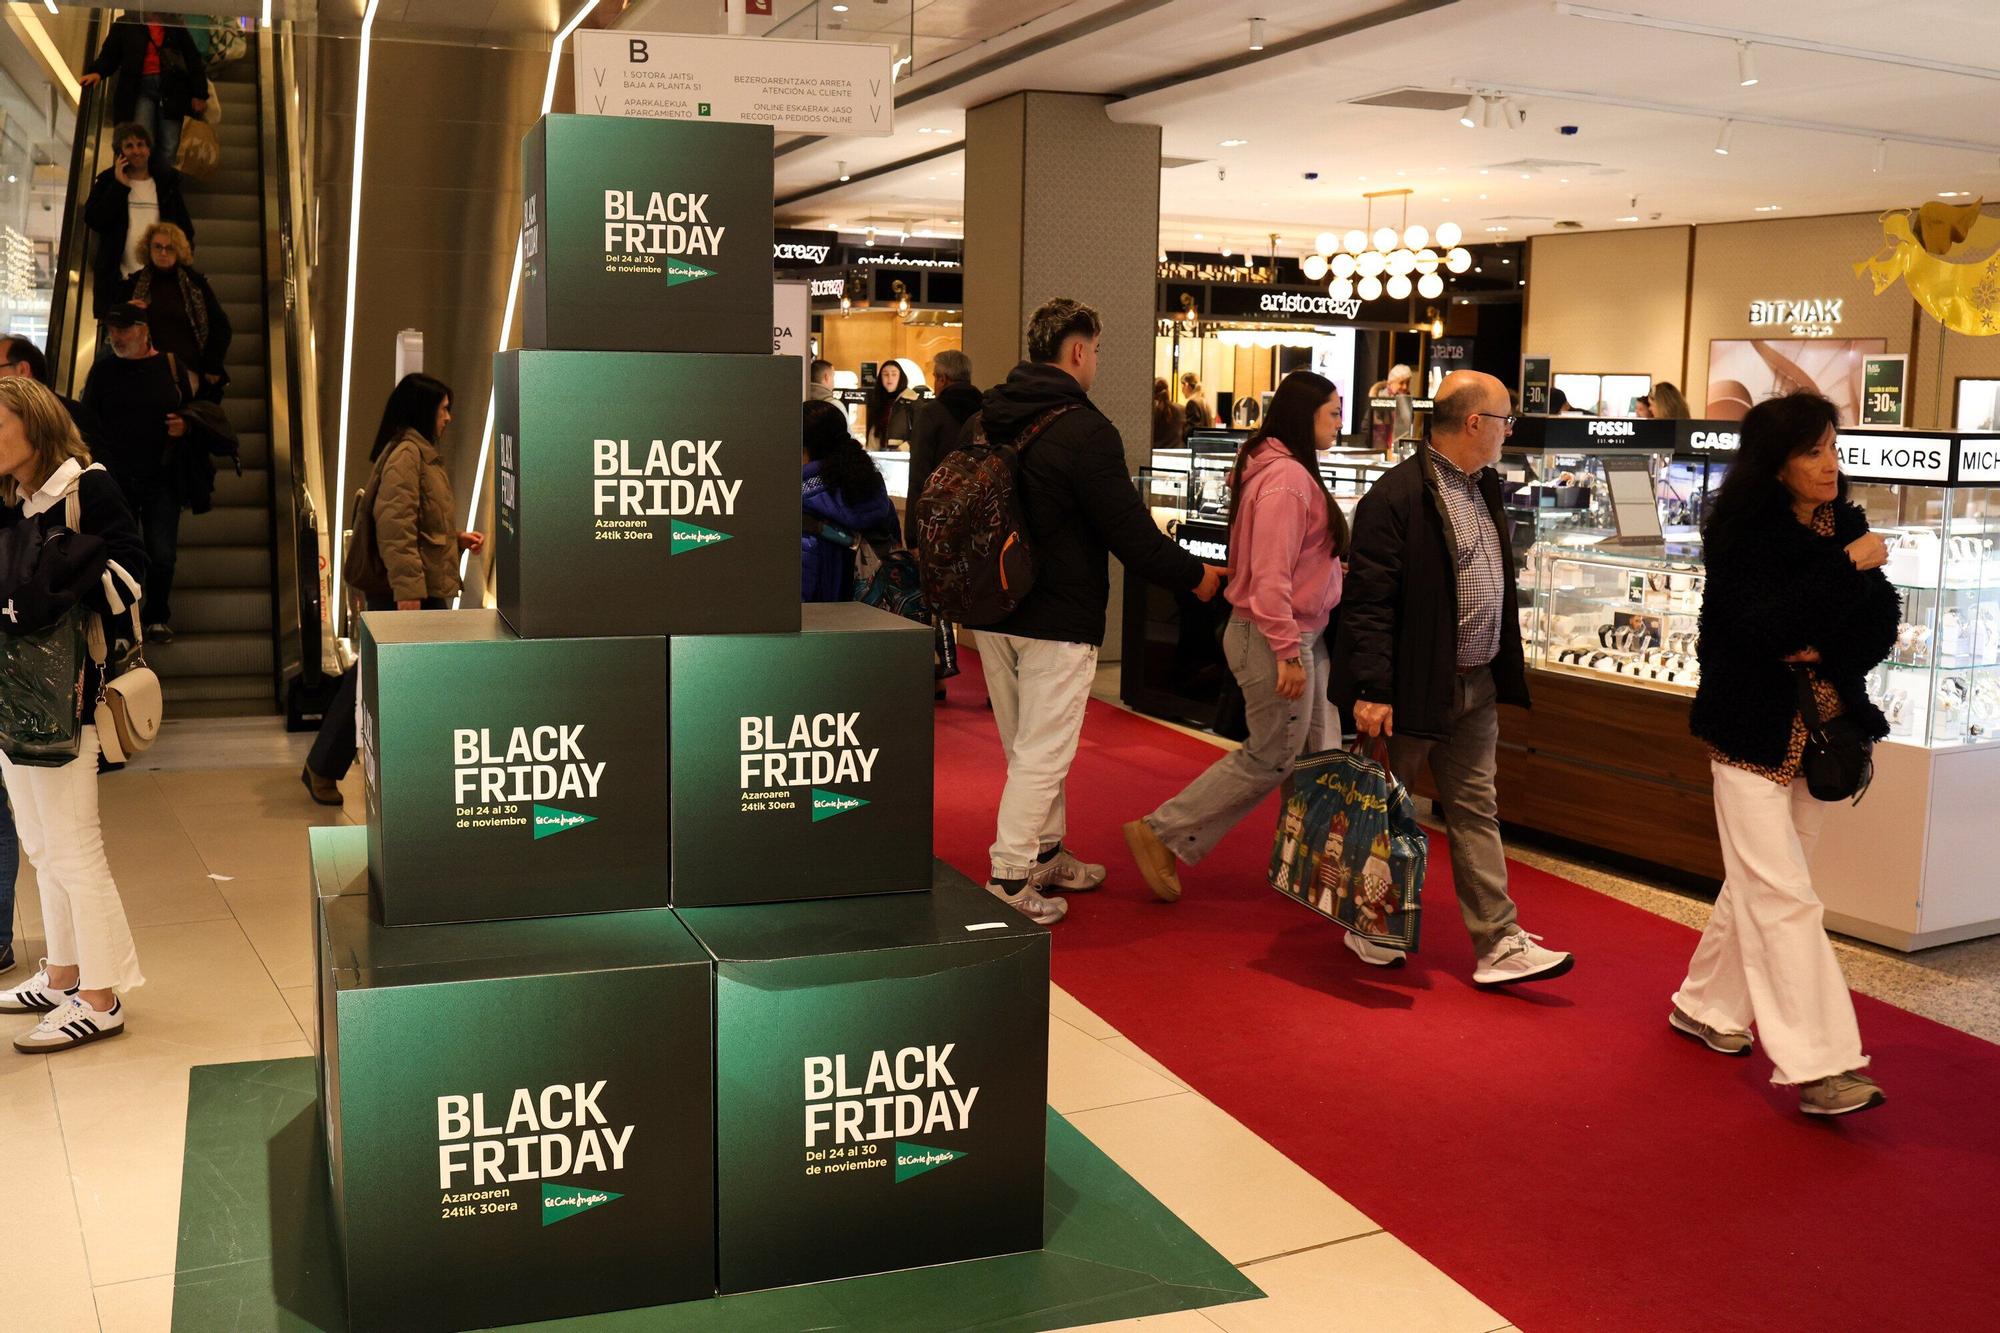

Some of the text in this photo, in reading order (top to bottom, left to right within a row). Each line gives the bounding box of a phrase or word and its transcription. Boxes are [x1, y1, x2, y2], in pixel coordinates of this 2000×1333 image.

[629, 39, 649, 63] B
[630, 71, 666, 80] SOTORA
[668, 72, 694, 81] JAITSI
[734, 76, 852, 88] BEZEROARENTZAKO ARRETA
[624, 81, 646, 89] BAJA
[657, 82, 692, 90] PLANTA
[762, 86, 804, 95] ATENCIÓN
[624, 99, 688, 108] APARKALEKUA
[754, 104, 853, 114] ONLINE ESKAERAK JASO
[624, 110, 693, 118] APARCAMIENTO
[740, 112, 852, 124] RECOGIDA PEDIDOS ONLINE
[605, 190, 708, 223] BLACK
[605, 222, 726, 256] FRIDAY
[618, 265, 662, 273] noviembre
[1260, 292, 1362, 319] aristocrazy
[1748, 299, 1842, 324] BITXIAK
[1868, 393, 1896, 412] -30%
[1588, 421, 1635, 436] FOSSIL
[594, 439, 723, 476] BLACK
[1881, 449, 1941, 469] KORS
[594, 479, 743, 516] FRIDAY
[595, 519, 647, 528] Azaroaren
[595, 530, 653, 540] 24tik 30era
[740, 712, 860, 751] BLACK
[454, 724, 585, 765] BLACK
[740, 748, 880, 788] FRIDAY
[454, 762, 606, 804] FRIDAY
[742, 791, 790, 800] Azaroaren
[456, 805, 518, 816] Del 24 al 30
[741, 801, 795, 812] 24tik 30era
[456, 817, 526, 828] de noviembre
[804, 1043, 956, 1101] BLACK
[437, 1080, 608, 1140] BLACK
[805, 1086, 980, 1147] FRIDAY
[439, 1124, 635, 1190] FRIDAY
[806, 1144, 877, 1161] Del 24 al 30
[806, 1157, 887, 1175] de noviembre
[442, 1188, 510, 1204] Azaroaren
[442, 1201, 518, 1219] 24tik 30era
